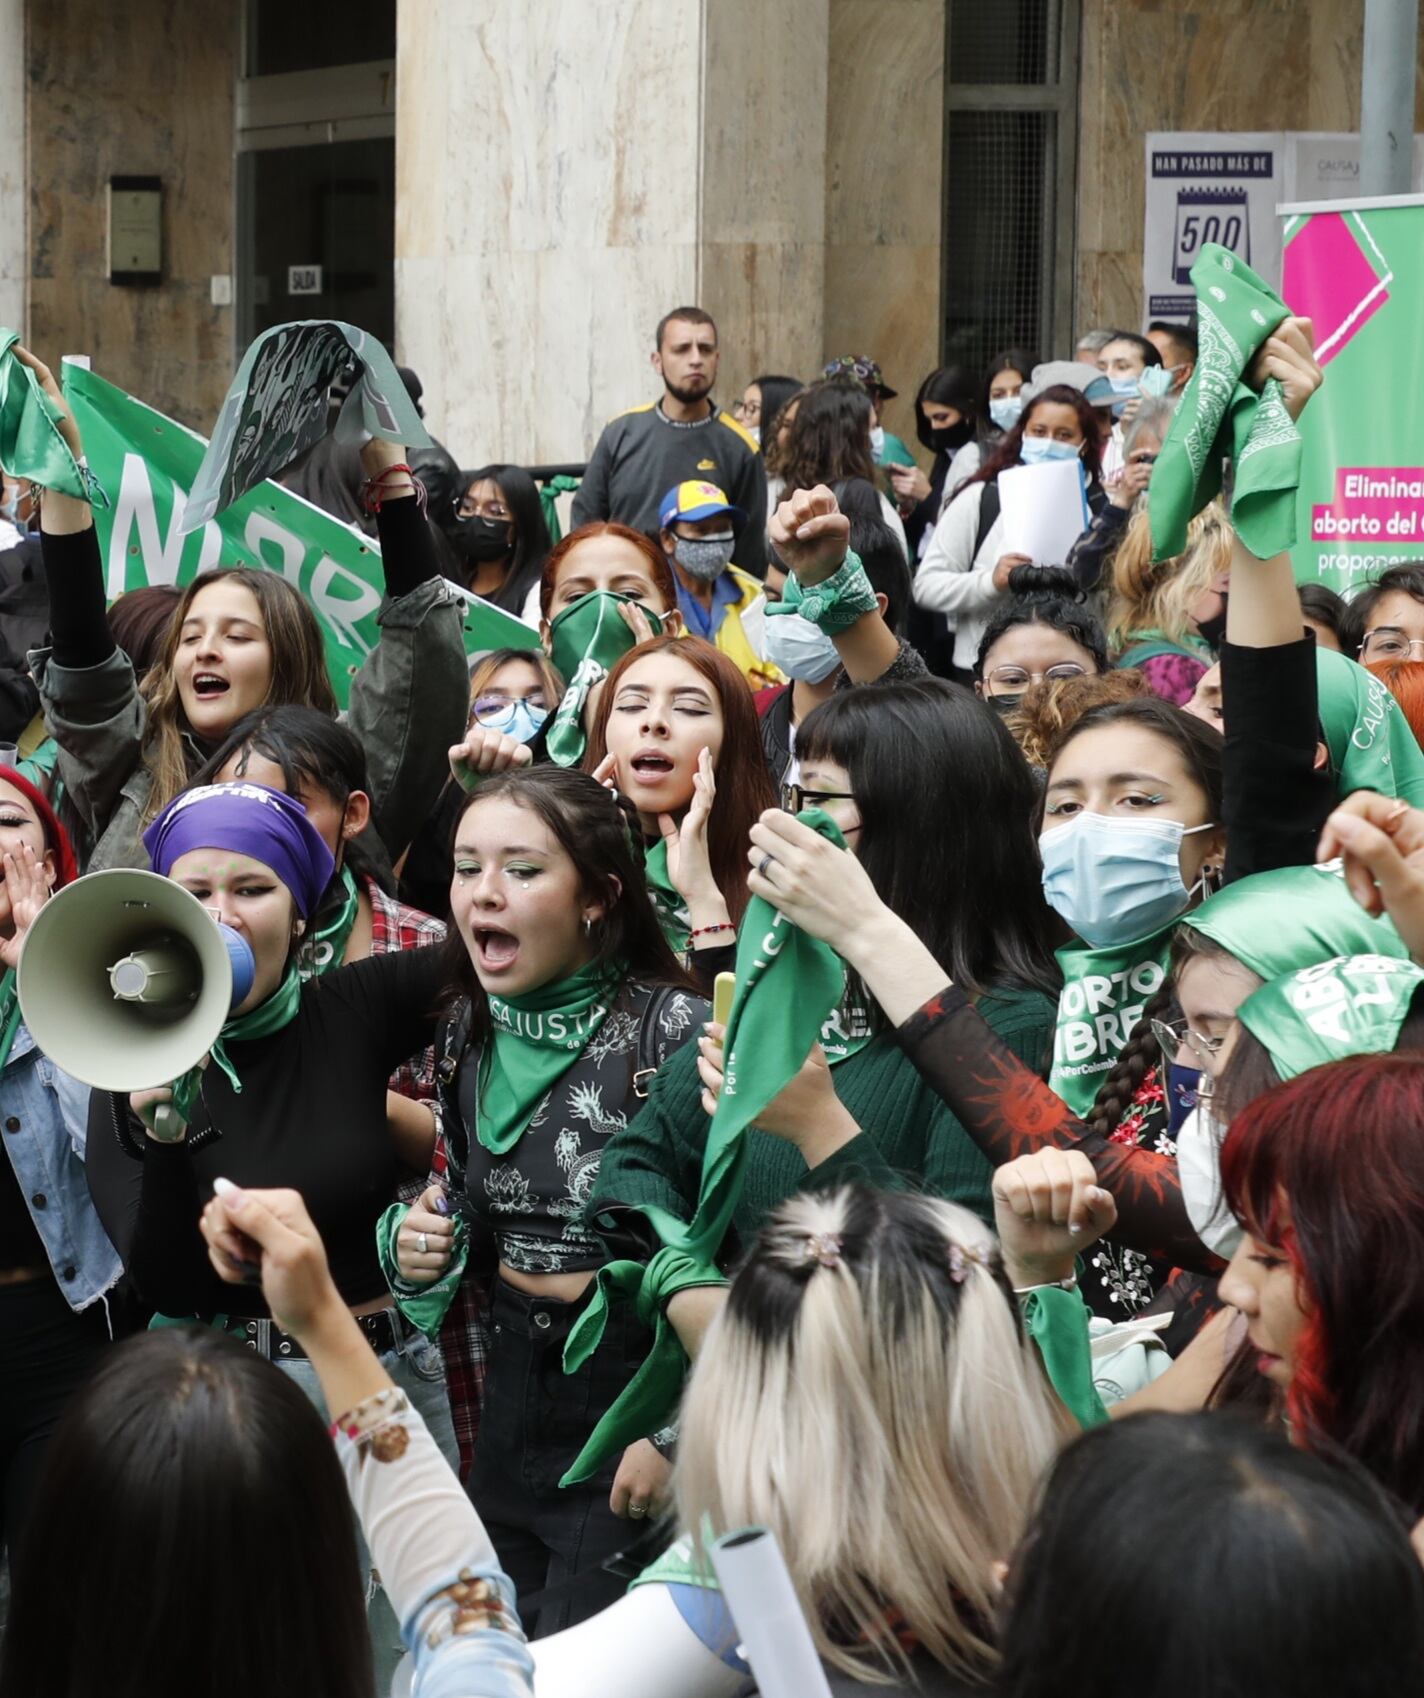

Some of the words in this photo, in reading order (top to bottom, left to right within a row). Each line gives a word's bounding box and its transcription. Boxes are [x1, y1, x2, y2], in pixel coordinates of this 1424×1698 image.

[1155, 156, 1177, 171] HAN
[1181, 156, 1224, 171] PASADO
[1227, 153, 1251, 171] MÁS
[1253, 156, 1266, 171] DE
[1180, 215, 1242, 254] 500
[1344, 474, 1424, 498] Elimina
[1314, 510, 1381, 534] aborto
[1385, 511, 1417, 535] del
[724, 1071, 737, 1096] Por
